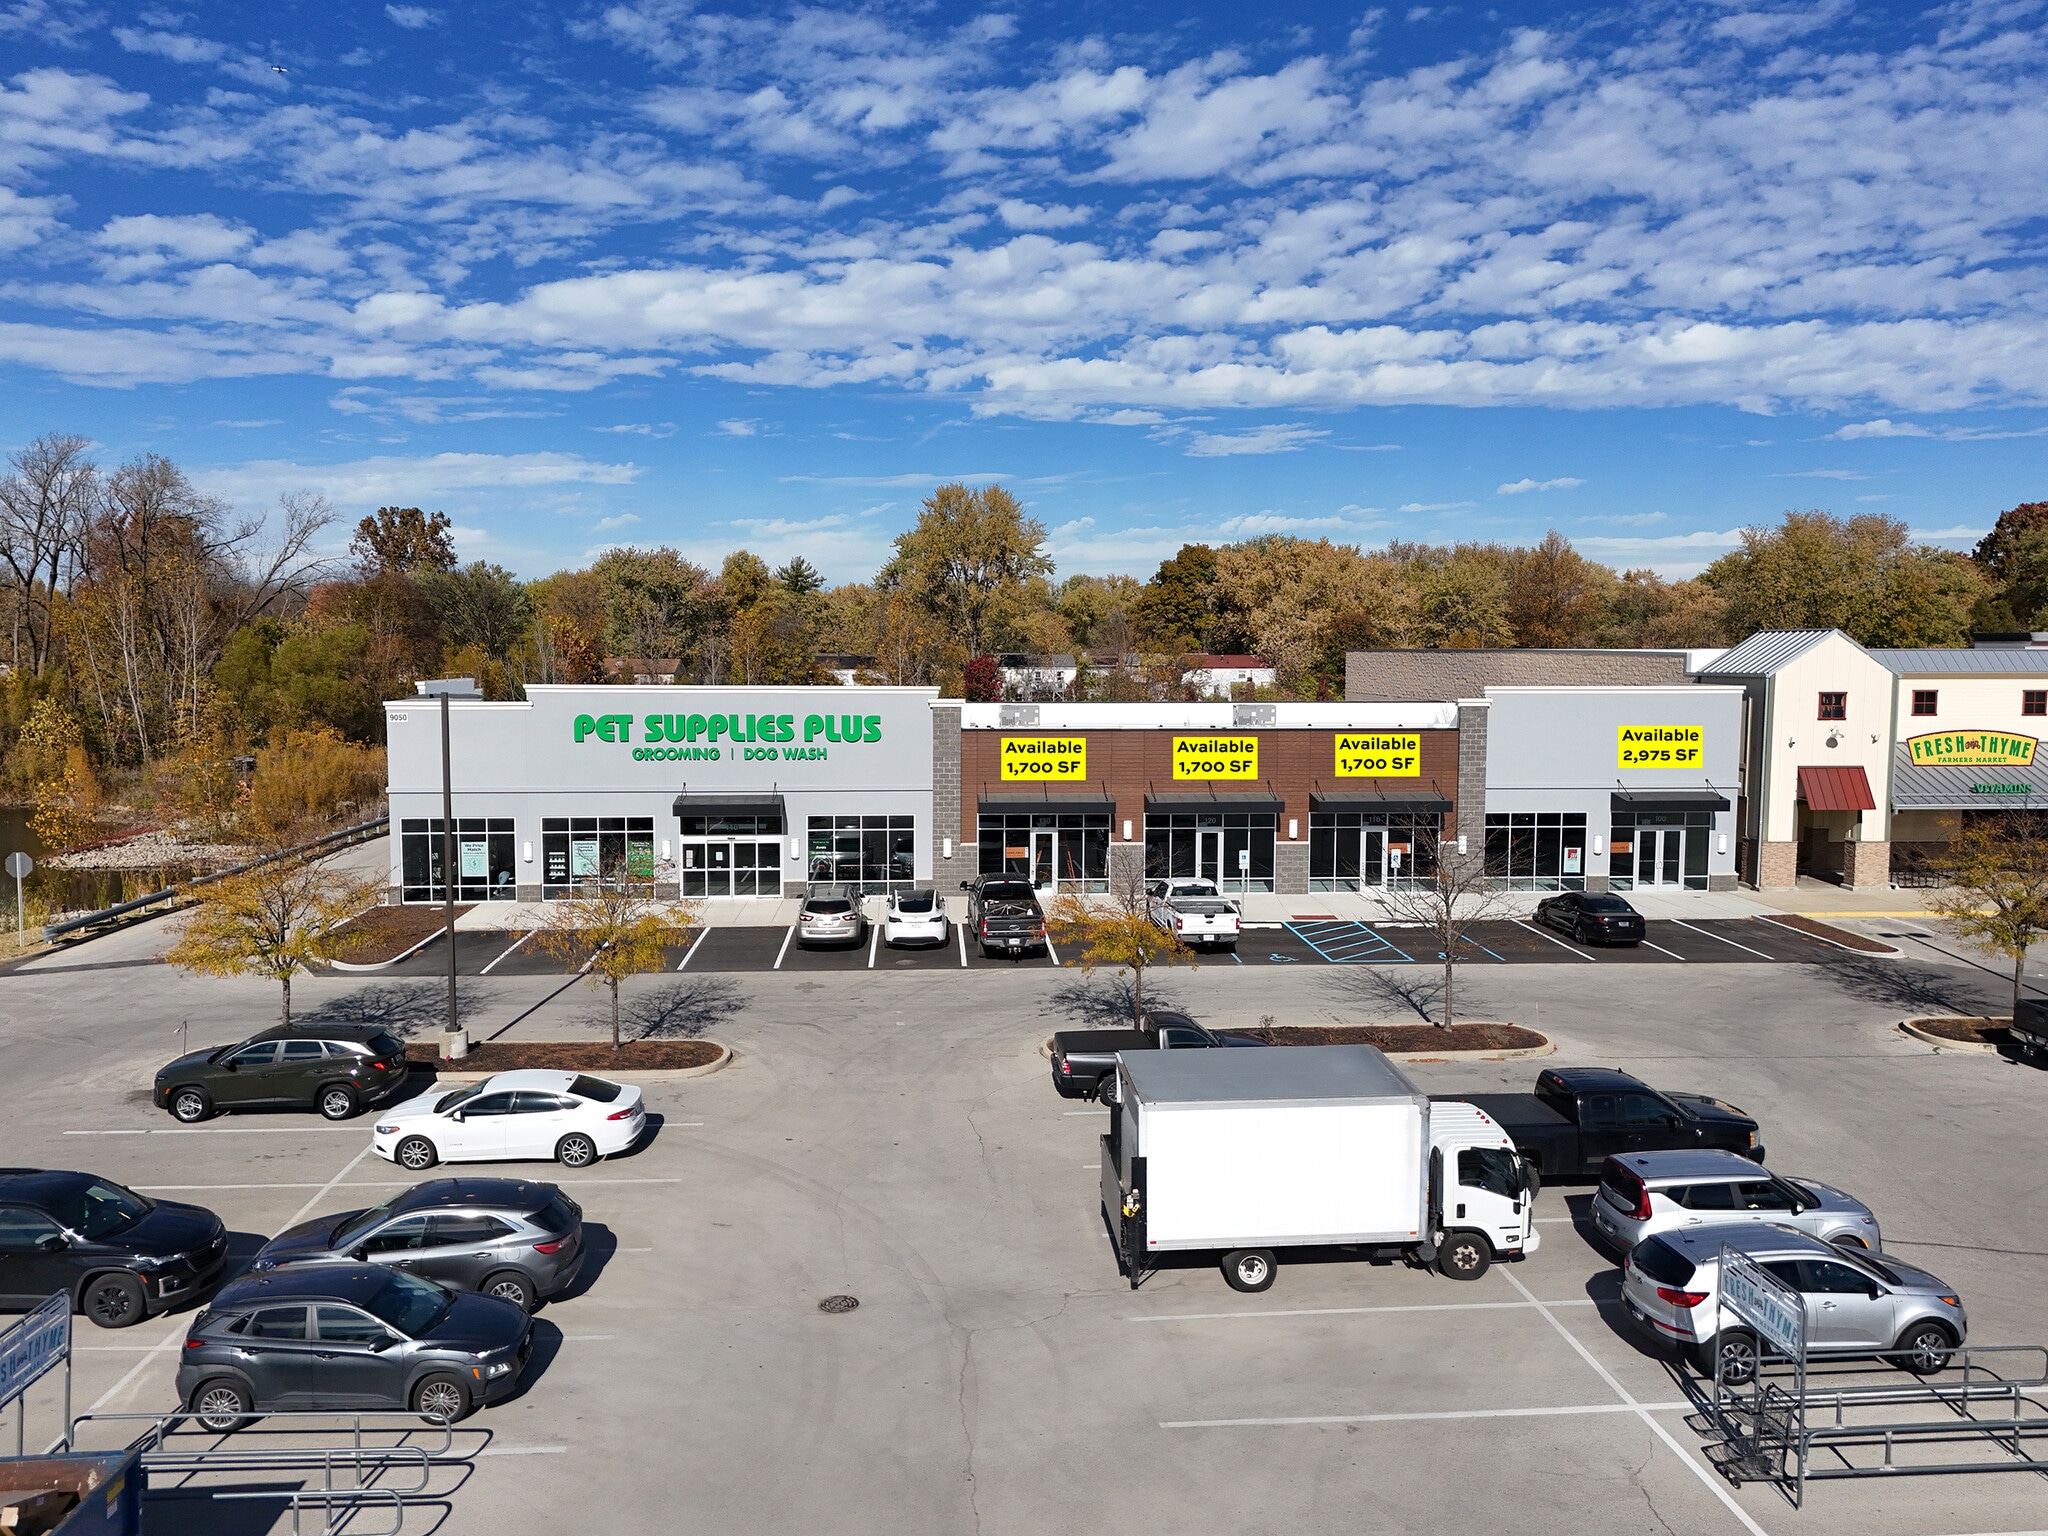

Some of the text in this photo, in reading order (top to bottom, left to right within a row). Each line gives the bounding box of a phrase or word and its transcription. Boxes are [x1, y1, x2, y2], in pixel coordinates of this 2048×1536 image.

[574, 714, 882, 743] PET SUPPLIES PLUS
[632, 747, 828, 761] GROOMING DOG WASH
[1913, 736, 2032, 759] FRESH THYME
[1974, 783, 2033, 794] VITAMINS
[1723, 1274, 1754, 1307] FRESH
[1763, 1296, 1798, 1346] THYME
[28, 1325, 64, 1361] THYME
